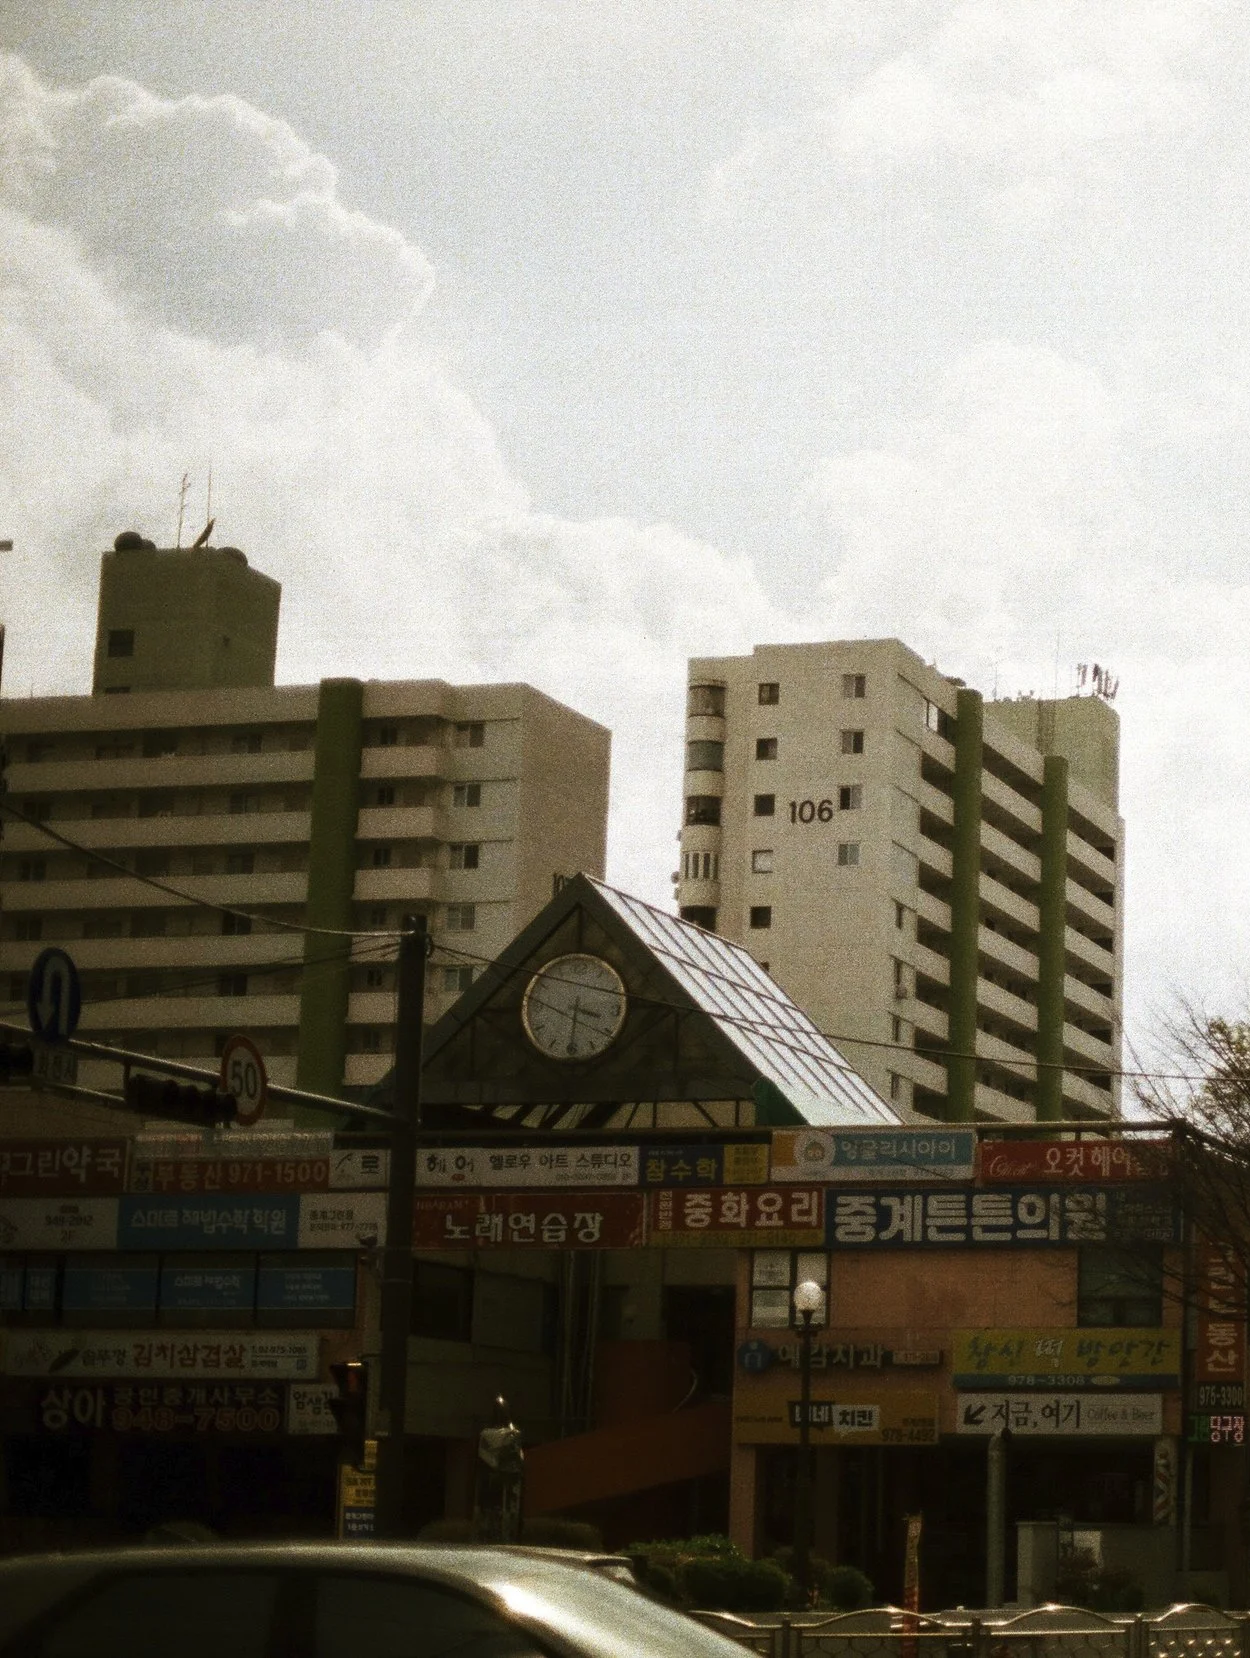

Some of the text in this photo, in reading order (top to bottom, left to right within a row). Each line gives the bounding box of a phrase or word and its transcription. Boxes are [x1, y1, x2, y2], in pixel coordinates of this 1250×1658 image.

[790, 799, 833, 824] 106
[231, 1061, 257, 1098] 50
[539, 1154, 568, 1170] 아트
[576, 1151, 632, 1169] 스튜디오
[841, 1138, 956, 1161] 잉글리시아이
[157, 1163, 221, 1191] 부동산
[227, 1163, 327, 1184] 971-1500
[684, 1191, 818, 1231] 중화요리
[834, 1194, 1106, 1243] 중계튼튼의원
[443, 1212, 604, 1242] 노래연습장
[1007, 1374, 1085, 1387] 978-3308
[40, 1384, 105, 1431] 상아
[114, 1386, 278, 1406] 공인중개사무소
[112, 1408, 280, 1432] 948-7500
[838, 1412, 872, 1429] 치킨
[992, 1400, 1038, 1428] 지금,
[1040, 1400, 1082, 1429] 여기
[1210, 1415, 1245, 1443] 당구장
